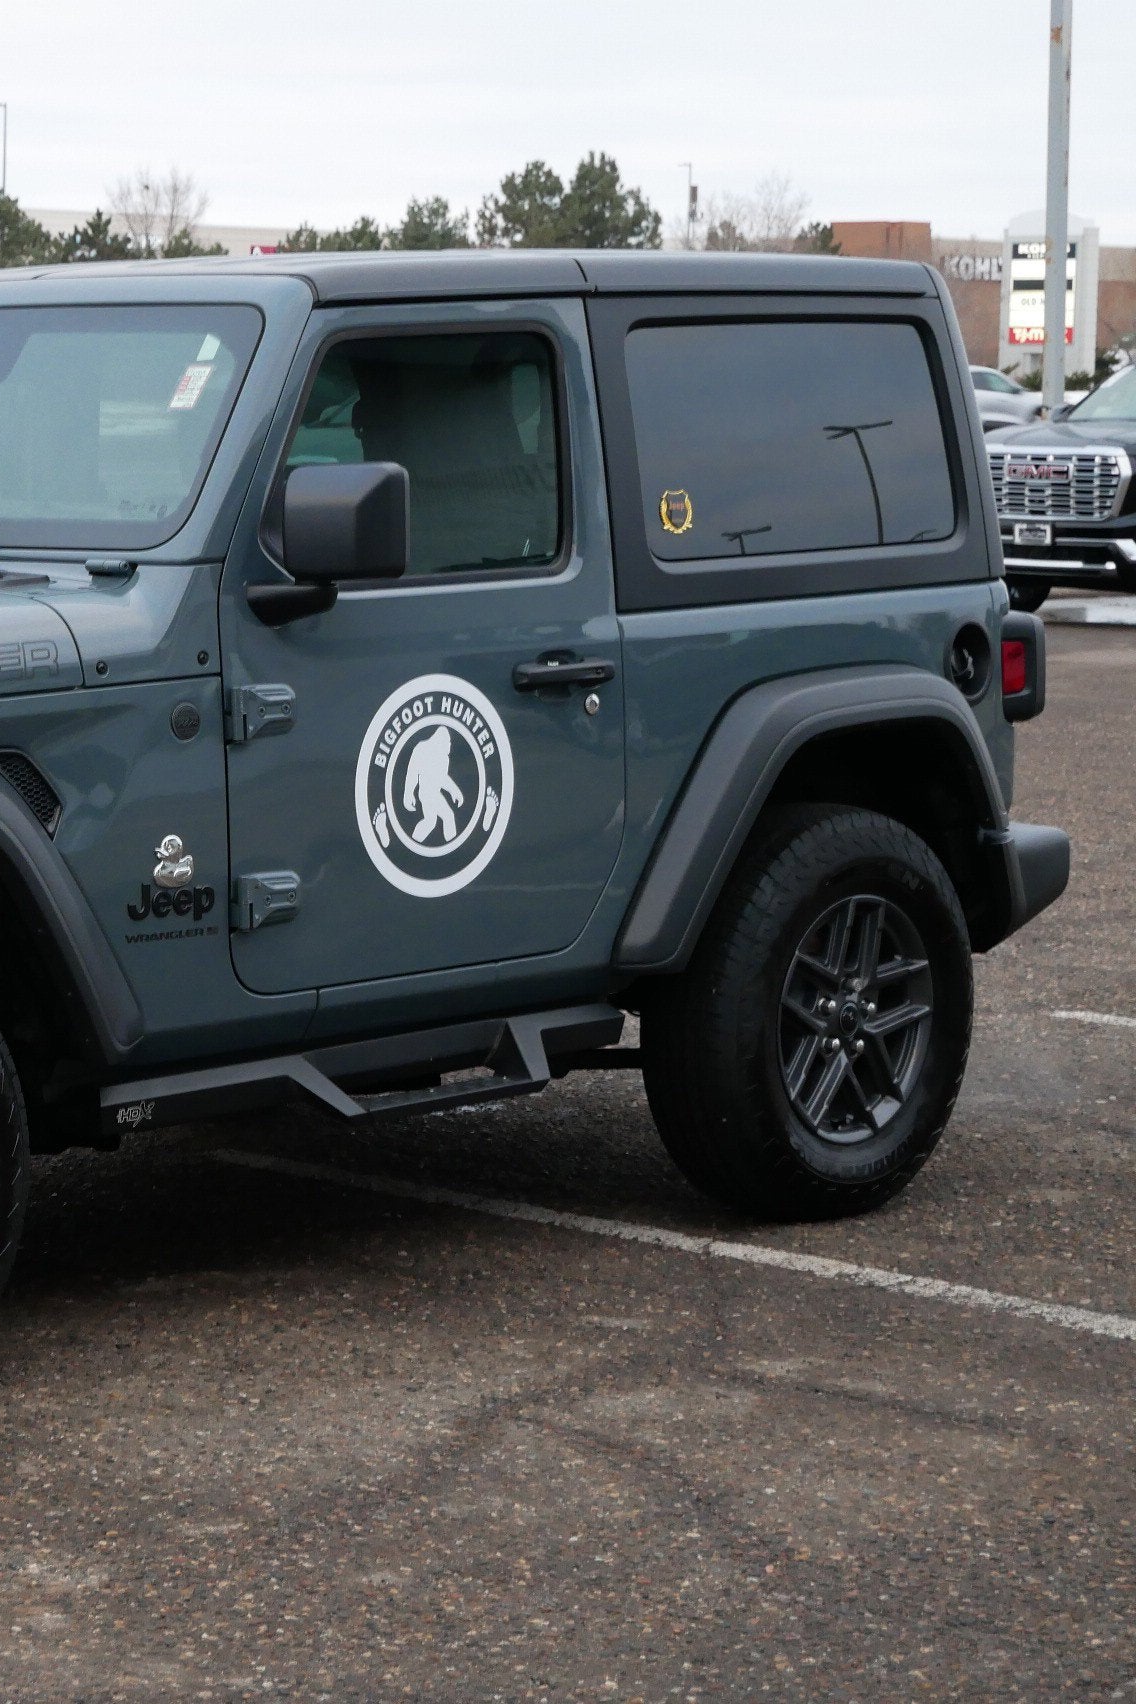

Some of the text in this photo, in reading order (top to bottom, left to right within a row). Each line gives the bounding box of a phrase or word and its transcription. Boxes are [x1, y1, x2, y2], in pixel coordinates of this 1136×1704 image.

[944, 254, 1003, 281] KOHL'
[374, 696, 495, 769] BIGFOOT HUNTER
[127, 883, 215, 921] Jeep
